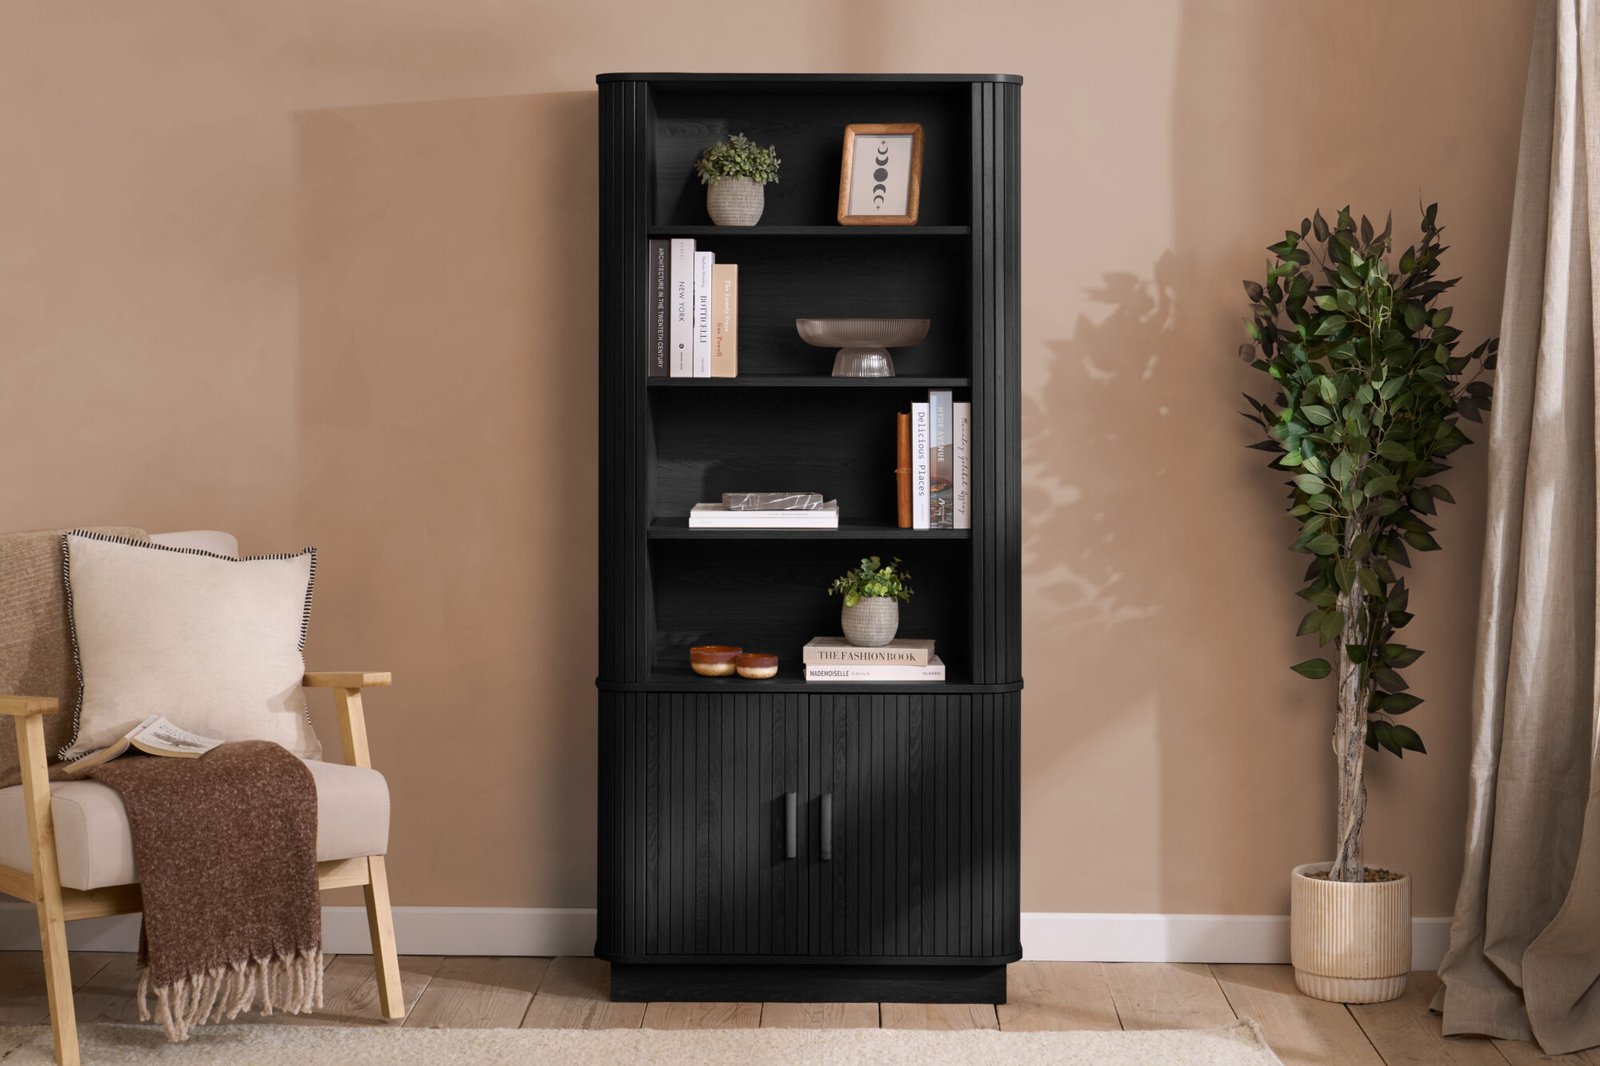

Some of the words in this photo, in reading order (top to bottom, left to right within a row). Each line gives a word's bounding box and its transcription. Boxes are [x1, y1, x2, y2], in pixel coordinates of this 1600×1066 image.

[699, 295, 707, 343] BOTTICELLI
[937, 406, 945, 427] HYDE
[917, 411, 926, 460] Delicious
[937, 430, 945, 462] AVENUE
[918, 464, 926, 496] Places
[818, 651, 839, 660] THE
[841, 651, 885, 661] FASHION
[886, 652, 916, 662] BOOK
